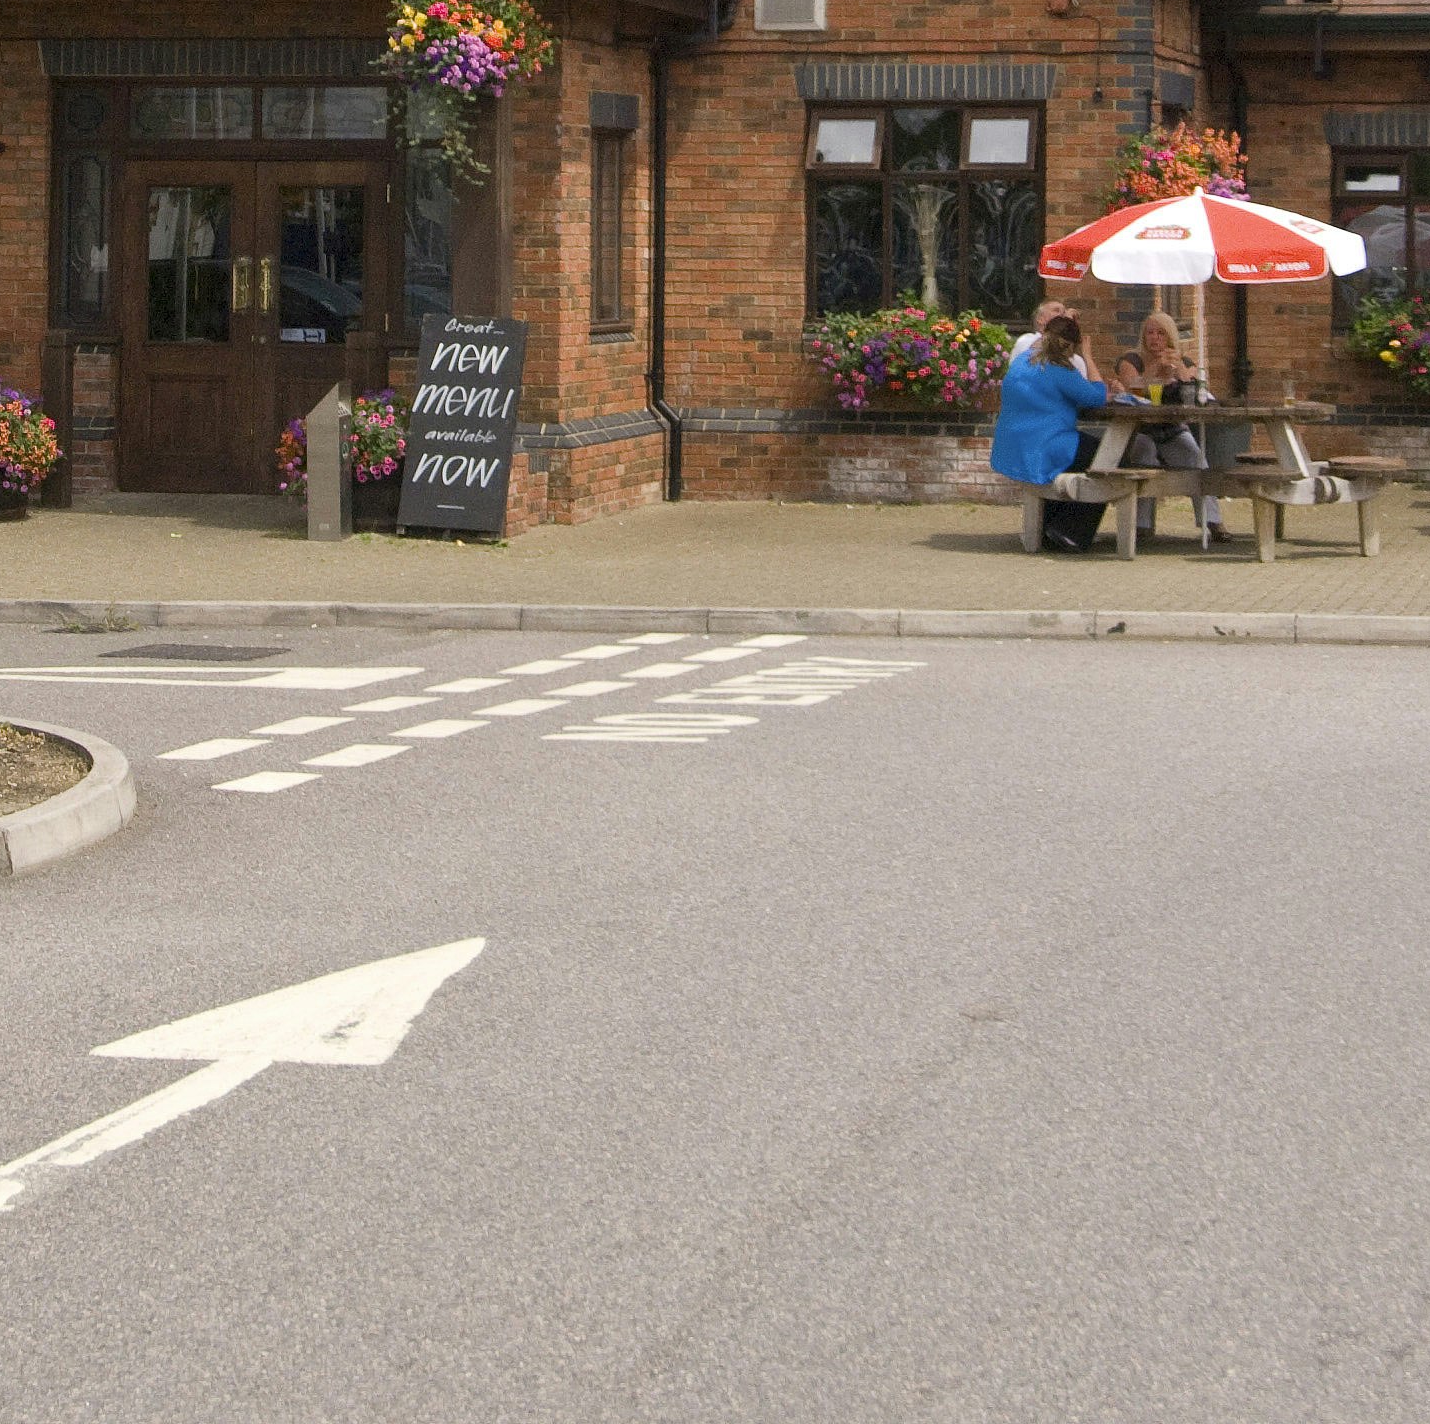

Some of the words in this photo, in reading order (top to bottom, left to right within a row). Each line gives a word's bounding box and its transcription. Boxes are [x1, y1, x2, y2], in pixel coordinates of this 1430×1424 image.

[429, 342, 510, 375] new
[411, 383, 515, 420] menu
[424, 428, 498, 444] available
[411, 452, 500, 489] now
